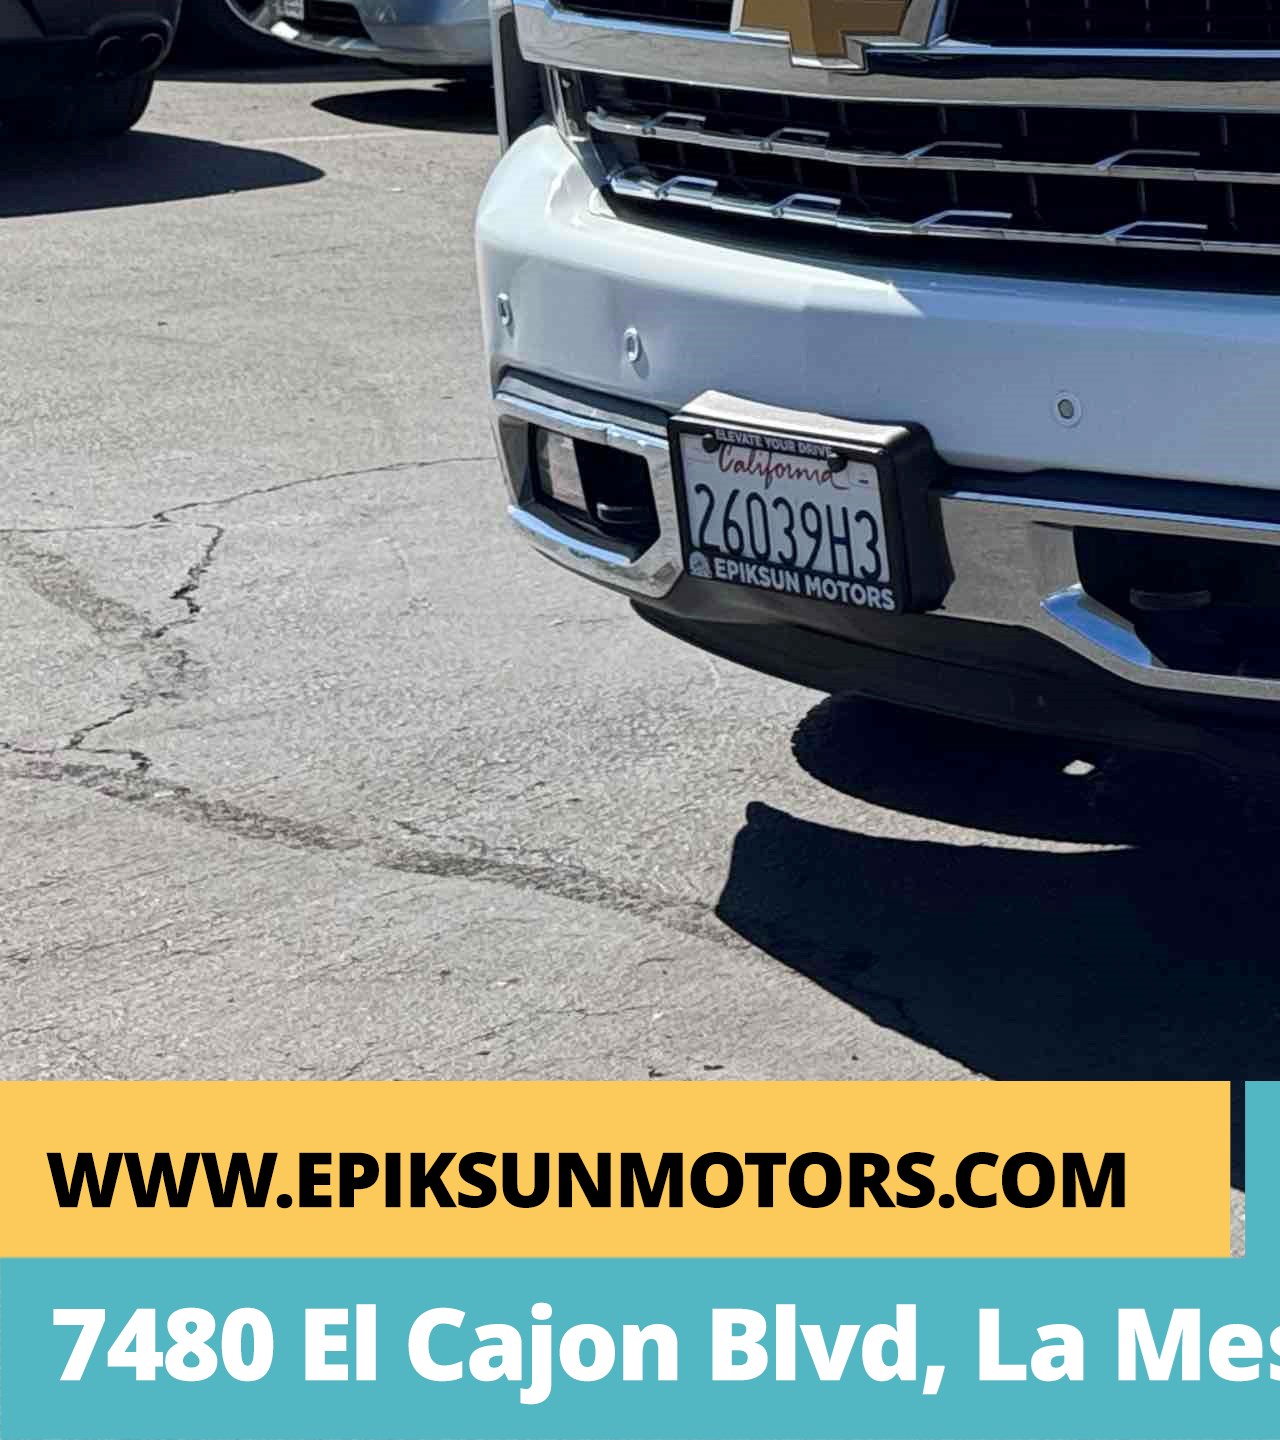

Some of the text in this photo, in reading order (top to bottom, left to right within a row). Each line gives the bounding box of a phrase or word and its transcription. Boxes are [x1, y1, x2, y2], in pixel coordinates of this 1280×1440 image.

[715, 428, 766, 448] ELEVATE
[719, 442, 848, 490] California
[694, 483, 883, 582] 26039H3
[714, 557, 896, 611] EPIKSUN MOTORS
